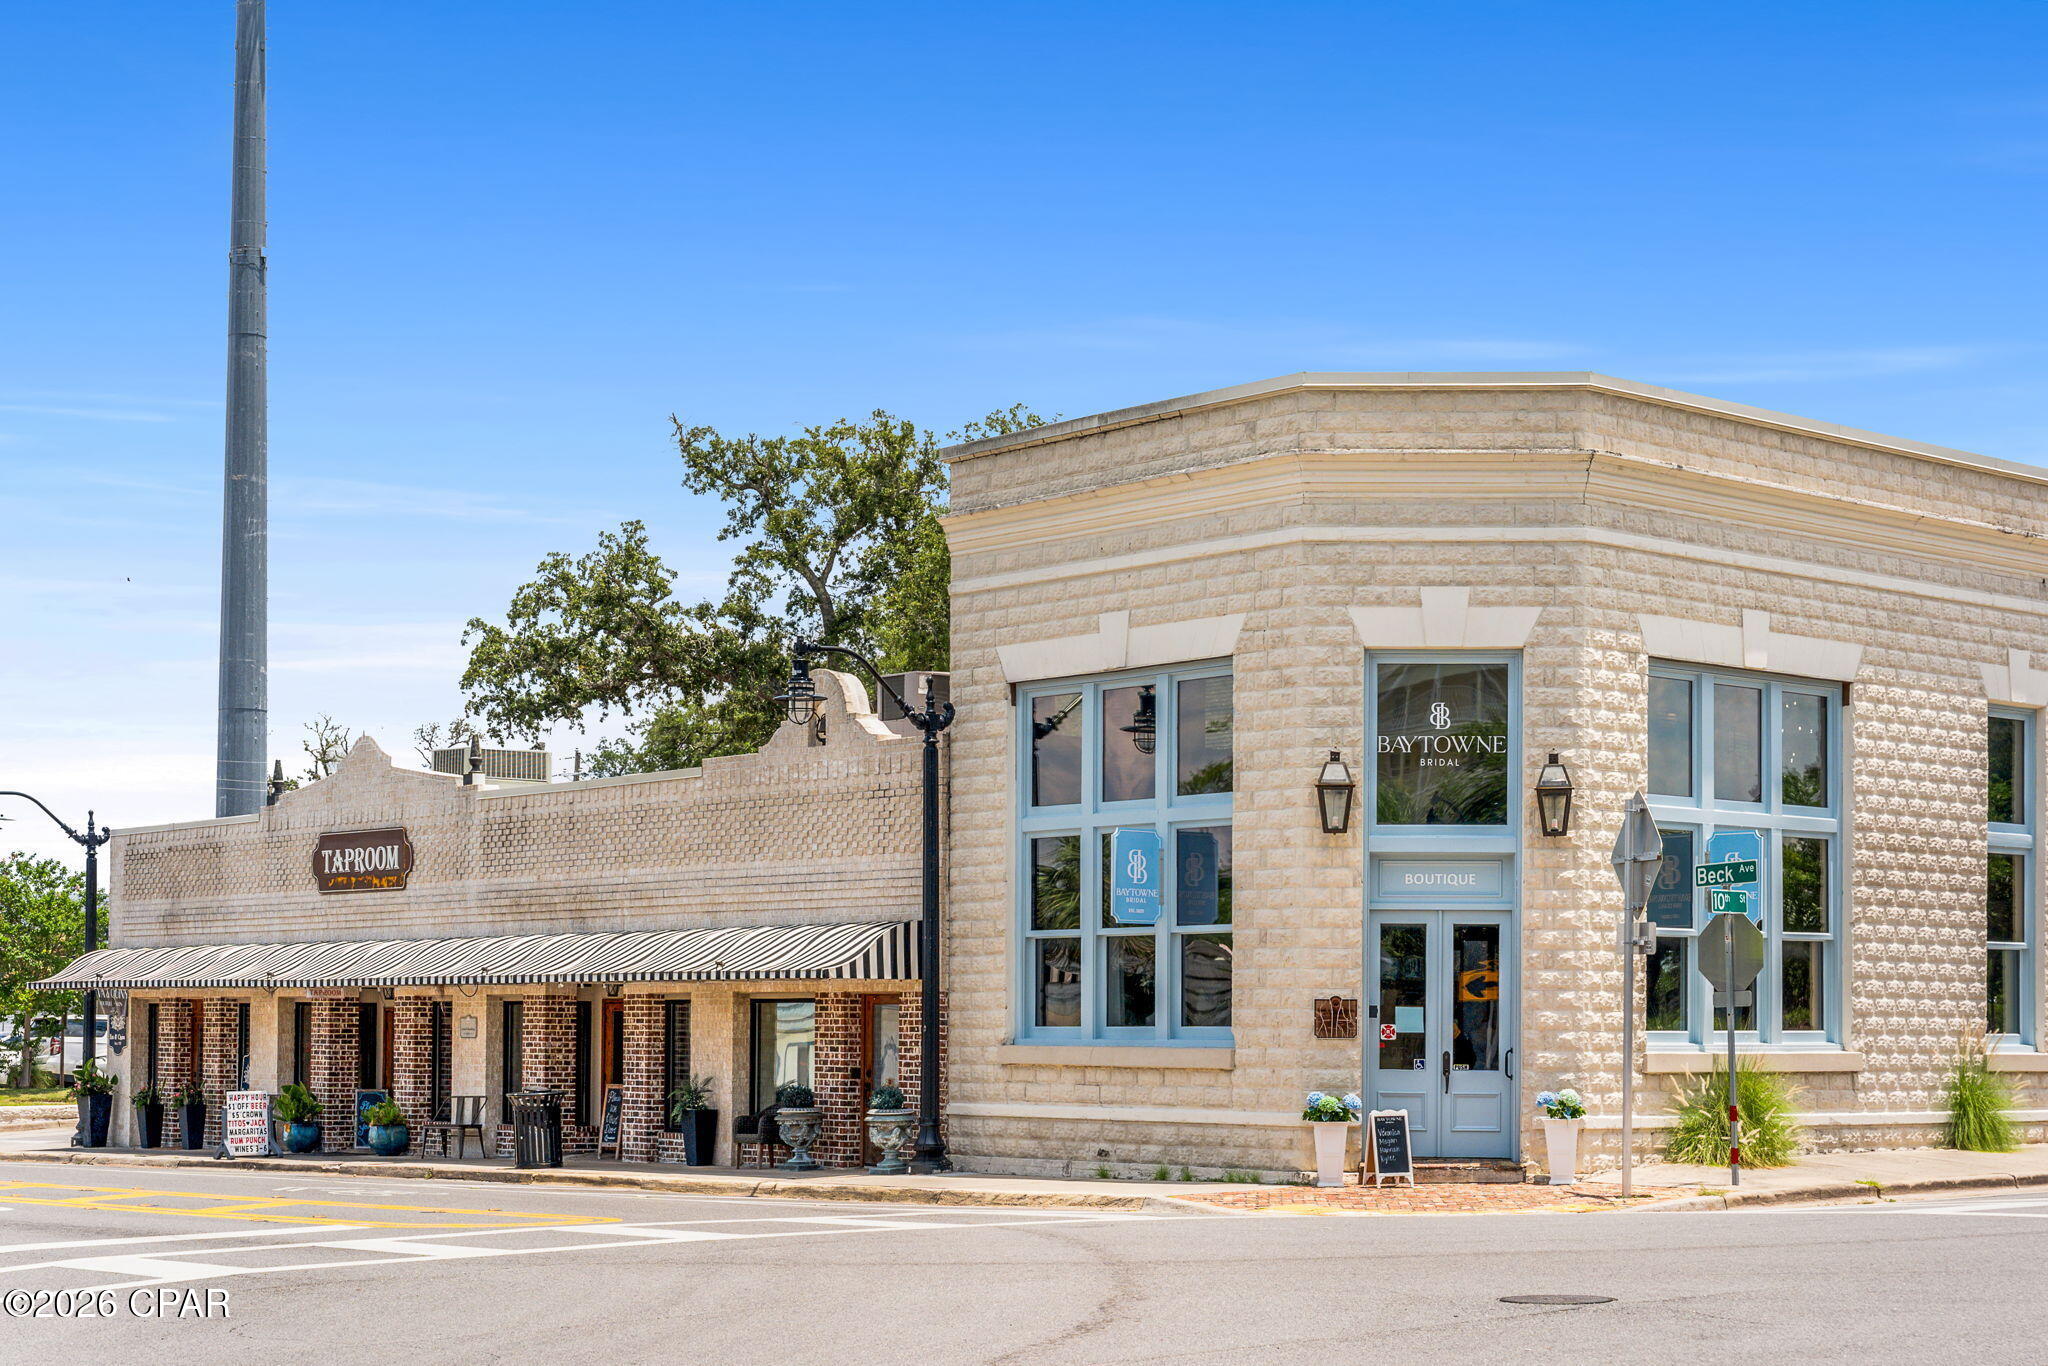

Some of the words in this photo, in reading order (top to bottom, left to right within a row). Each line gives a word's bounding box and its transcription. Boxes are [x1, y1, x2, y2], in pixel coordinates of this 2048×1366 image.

[1377, 735, 1507, 754] BAYTOWNE
[1419, 758, 1460, 767] BRIDAL
[321, 845, 400, 874] TAPROOM
[1405, 873, 1476, 886] BOUTIQUE
[1697, 866, 1735, 885] Beck
[1739, 864, 1755, 873] Ave
[1116, 887, 1160, 898] BAYTOWNE
[1713, 893, 1731, 910] 10th
[1739, 894, 1746, 904] St
